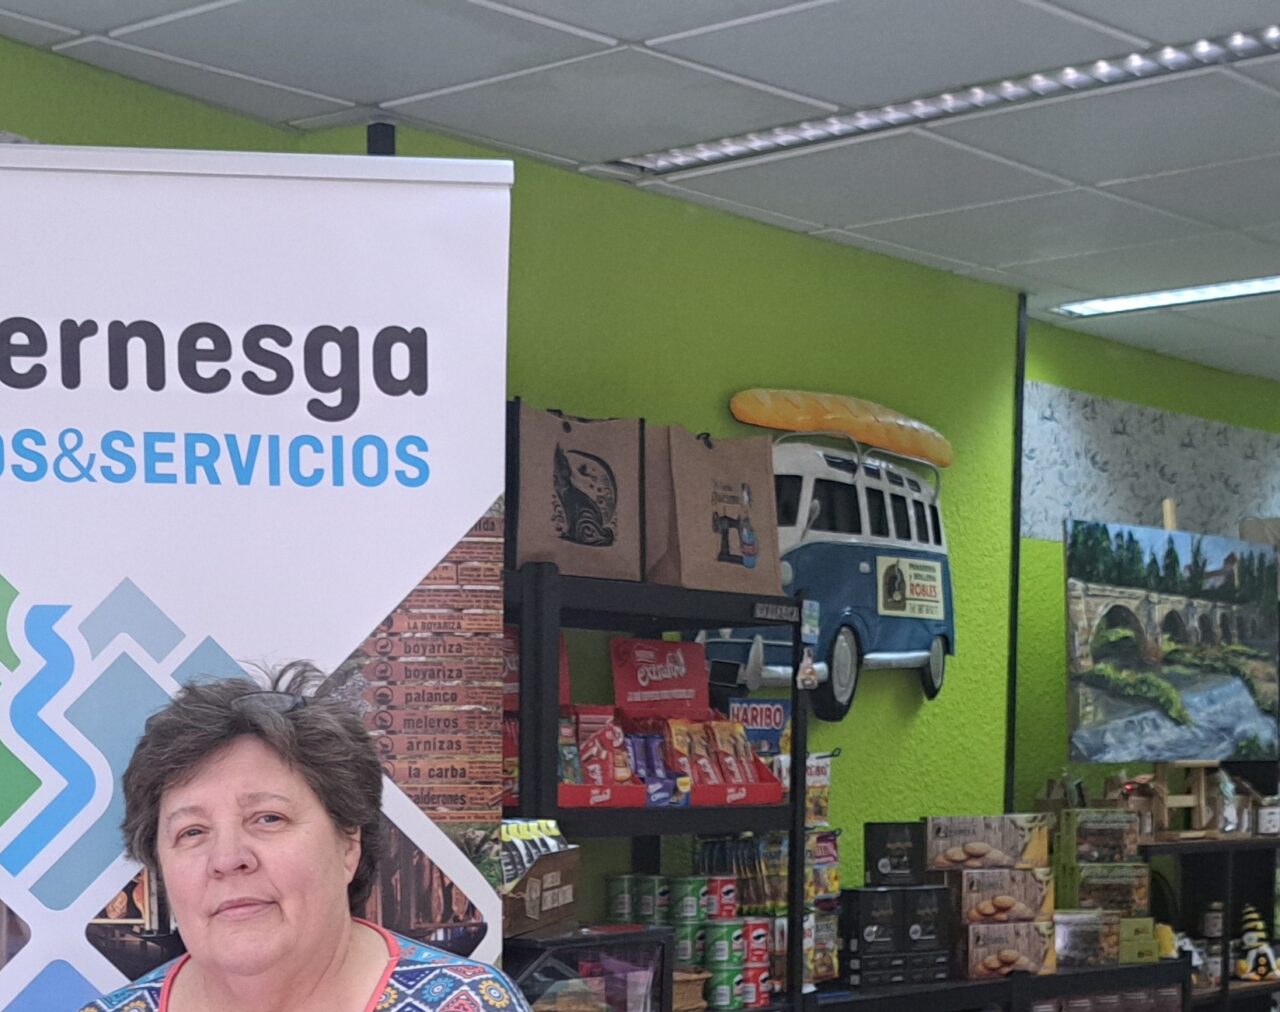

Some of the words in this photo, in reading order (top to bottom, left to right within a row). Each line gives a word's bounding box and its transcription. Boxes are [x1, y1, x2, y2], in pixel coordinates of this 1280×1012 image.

[910, 582, 937, 598] ROBLES
[404, 641, 463, 655] boyariza
[404, 666, 463, 680] boyariza
[405, 689, 459, 704] palanco
[403, 716, 459, 729] meleros
[729, 703, 784, 729] HARIBO
[408, 765, 421, 778] la
[428, 765, 467, 778] carba
